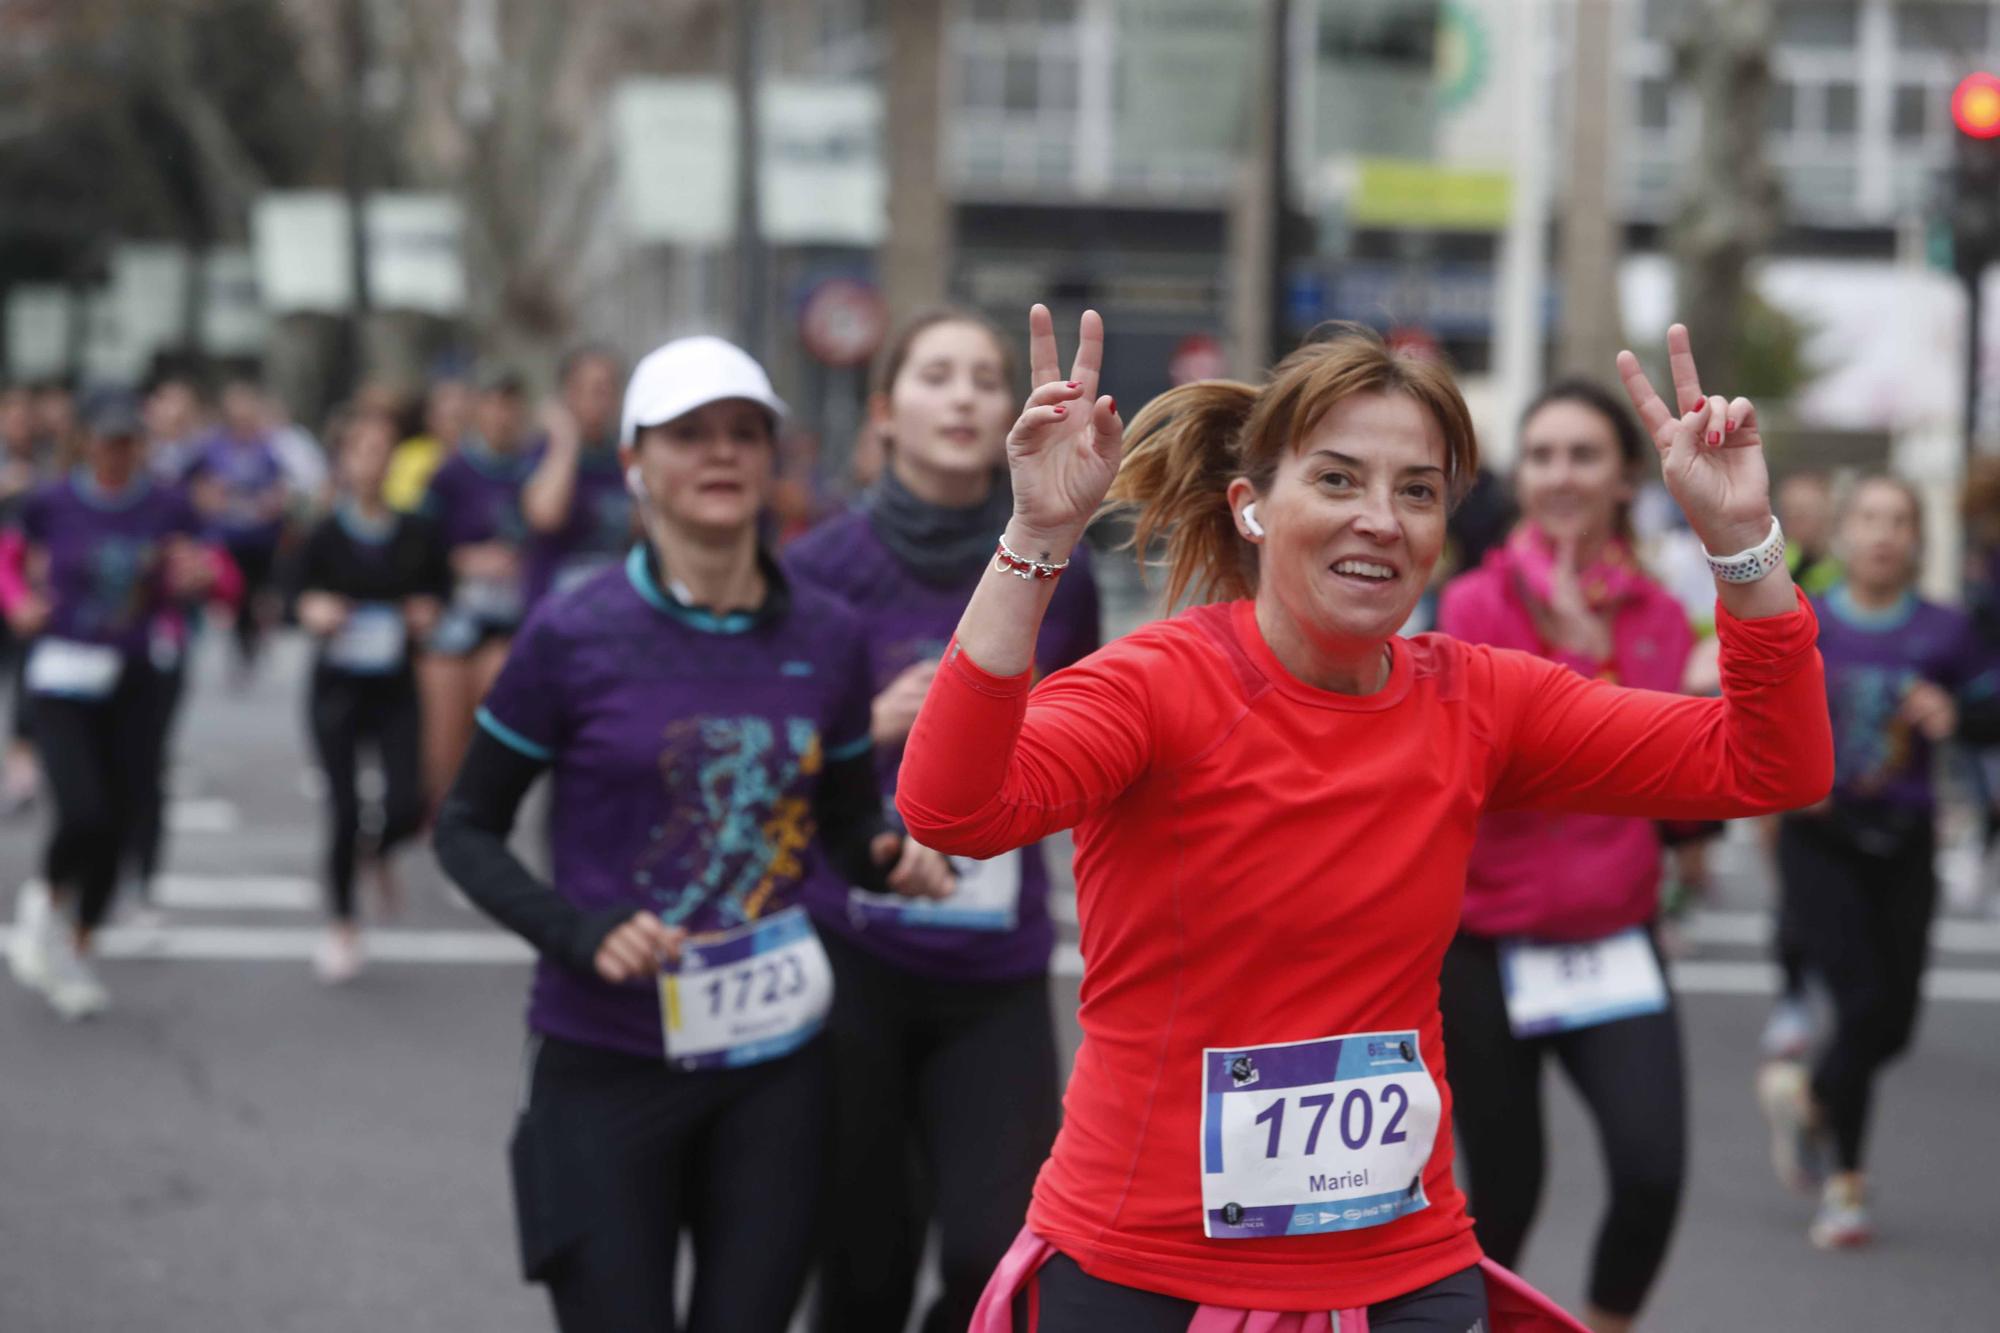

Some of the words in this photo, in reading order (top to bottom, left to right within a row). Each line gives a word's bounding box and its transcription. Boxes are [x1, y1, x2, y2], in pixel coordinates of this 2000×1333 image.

[705, 954, 806, 1016] 1723
[1255, 1083, 1409, 1159] 1702
[1309, 1169, 1369, 1193] Mariel
